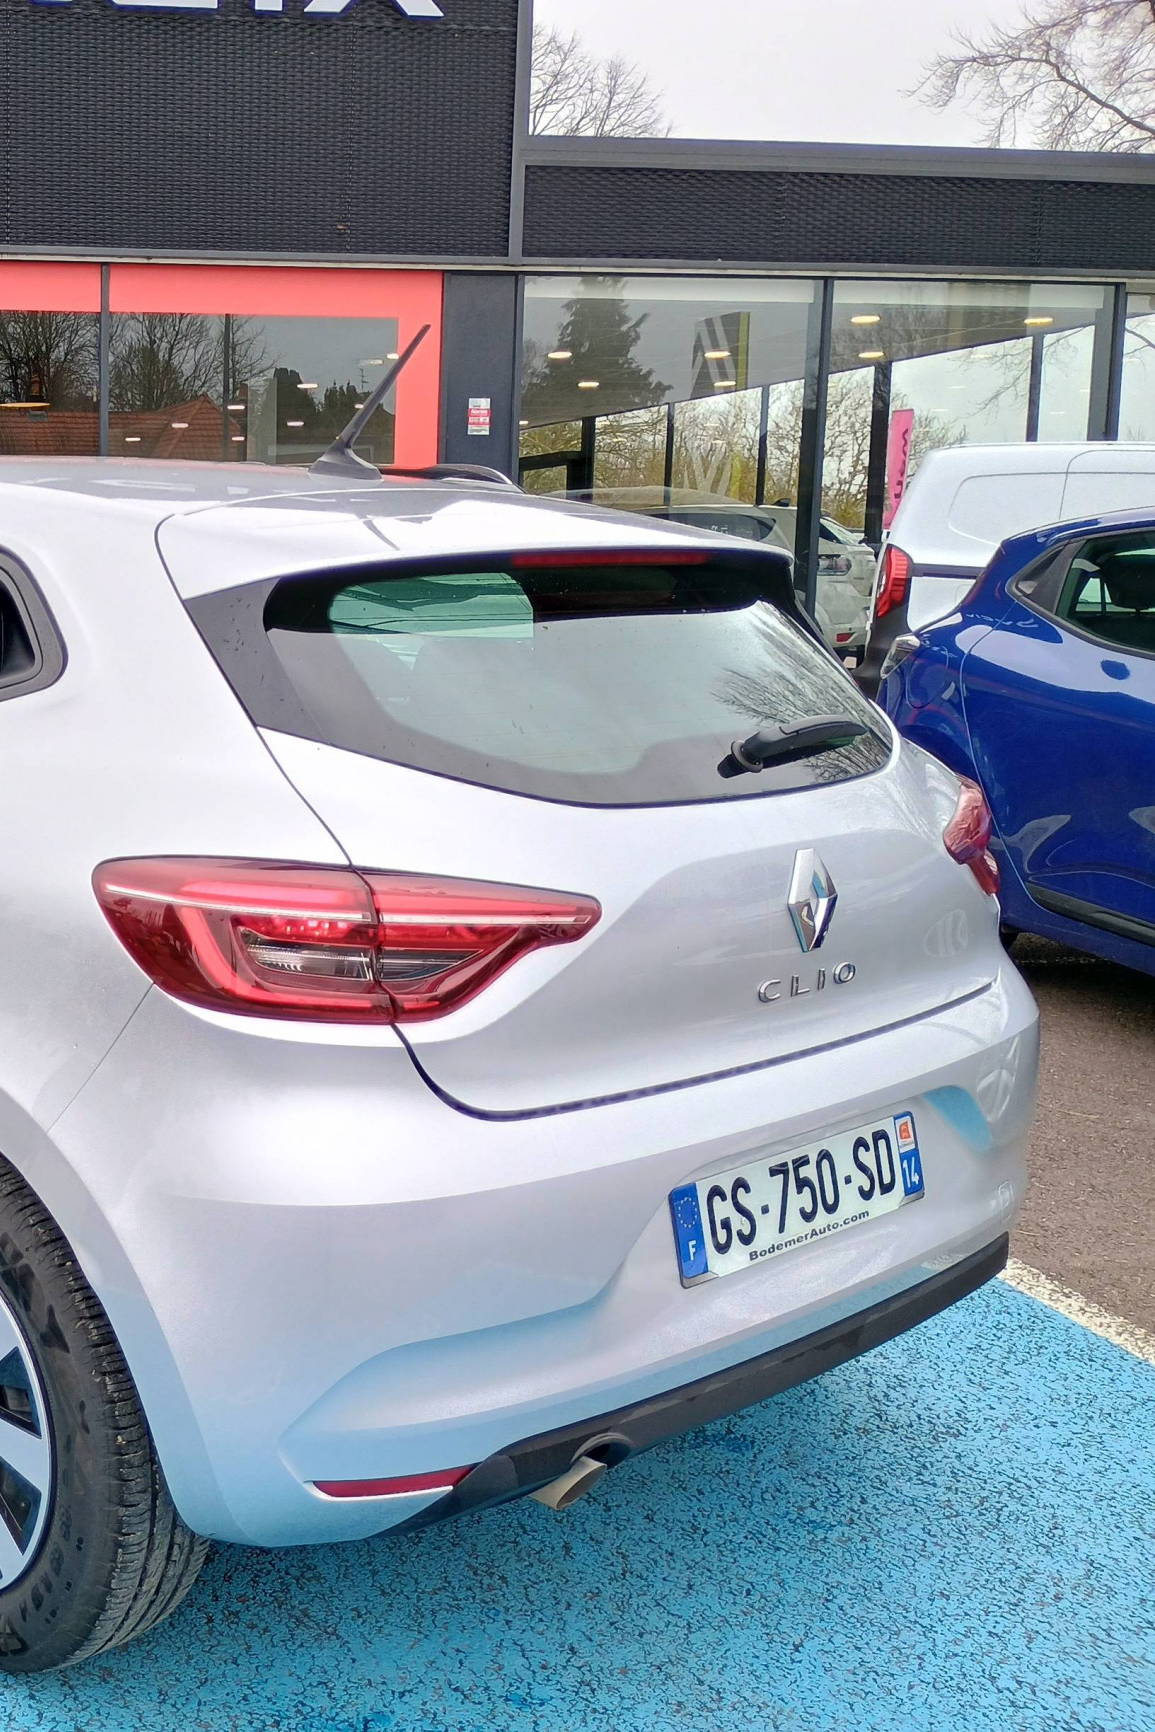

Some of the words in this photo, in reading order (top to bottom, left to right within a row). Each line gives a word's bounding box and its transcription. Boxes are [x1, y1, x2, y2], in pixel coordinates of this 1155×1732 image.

[758, 961, 857, 1003] CLIO
[687, 1240, 697, 1261] F
[706, 1129, 896, 1255] GS-750-SD
[902, 1156, 920, 1188] 14
[749, 1210, 870, 1262] BodemerAuto.com
